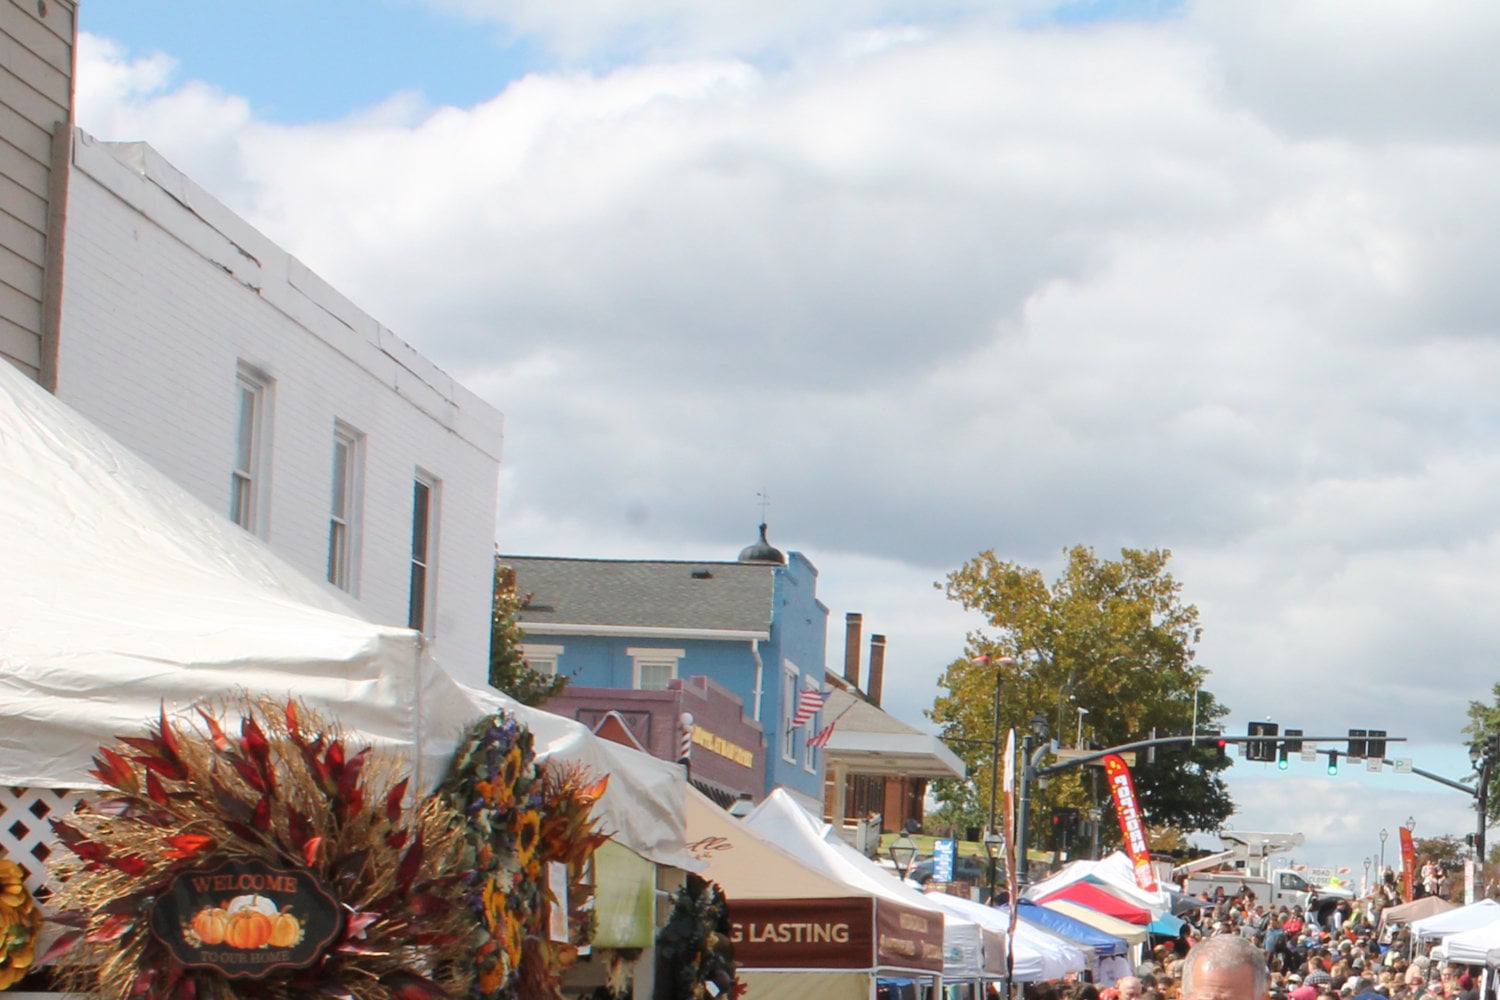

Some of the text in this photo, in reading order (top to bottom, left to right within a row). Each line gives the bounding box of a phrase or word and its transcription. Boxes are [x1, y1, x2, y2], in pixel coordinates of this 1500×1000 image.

[192, 873, 298, 893] WELCOME
[748, 923, 849, 943] LASTING
[201, 951, 291, 964] TO OUR HOME
